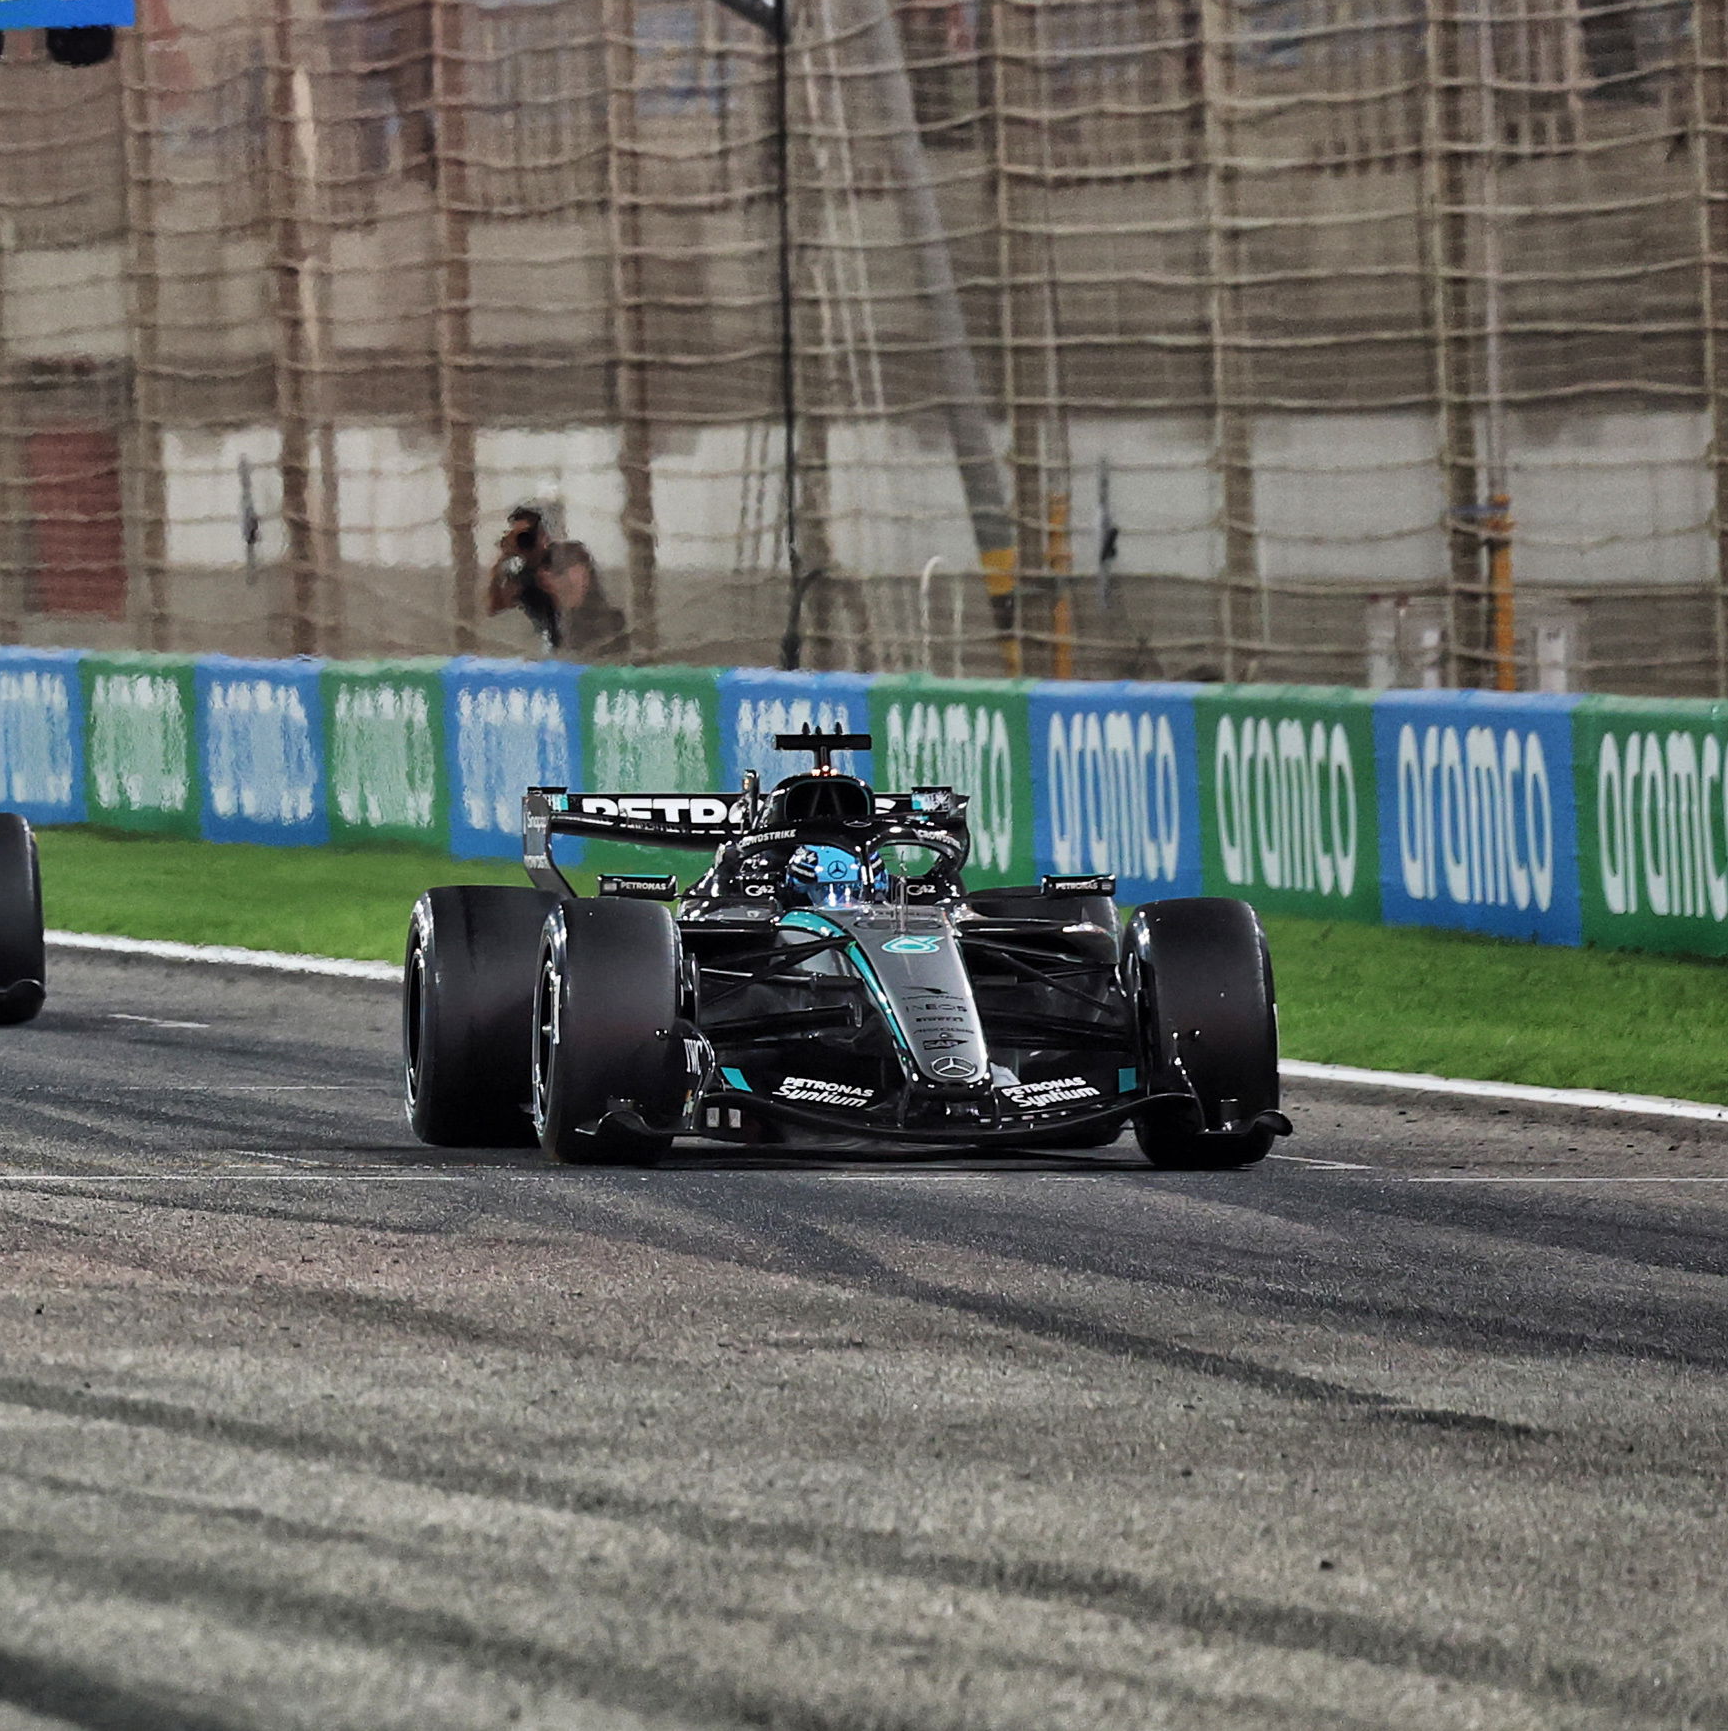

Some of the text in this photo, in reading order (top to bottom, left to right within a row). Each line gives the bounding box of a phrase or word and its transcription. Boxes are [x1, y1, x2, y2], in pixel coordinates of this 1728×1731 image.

[1048, 711, 1180, 882] aramco
[1215, 713, 1358, 897] aramco
[1397, 722, 1553, 913] aramco
[1597, 730, 1728, 924] aramc
[620, 881, 667, 891] PETRONAS
[1054, 881, 1099, 891] PETRONAS
[924, 1040, 959, 1050] SAP
[771, 1084, 868, 1109] Syntium
[782, 1076, 875, 1099] PETRONAS
[1001, 1076, 1087, 1099] PETRONAS
[1010, 1085, 1102, 1109] Syntium
